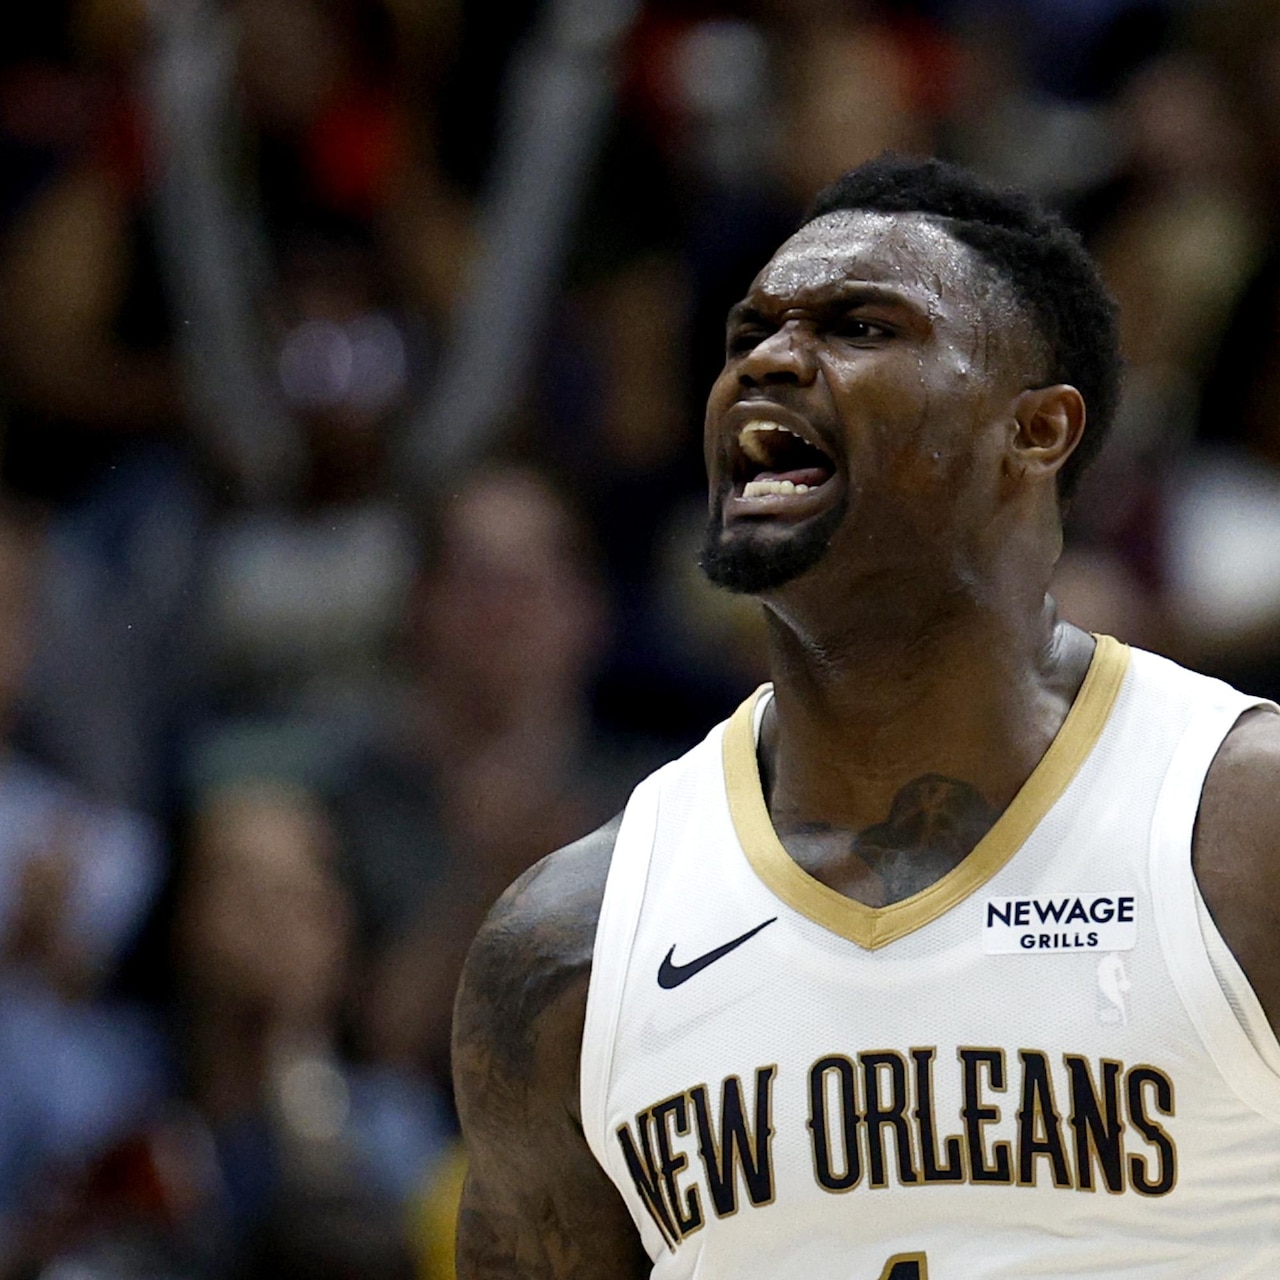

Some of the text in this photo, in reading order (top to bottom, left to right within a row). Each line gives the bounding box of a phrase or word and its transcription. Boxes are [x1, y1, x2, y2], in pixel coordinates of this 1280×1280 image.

[986, 896, 1135, 928] NEWAGE
[1019, 931, 1099, 949] GRILLS
[617, 1046, 1176, 1253] NEW ORLEANS
